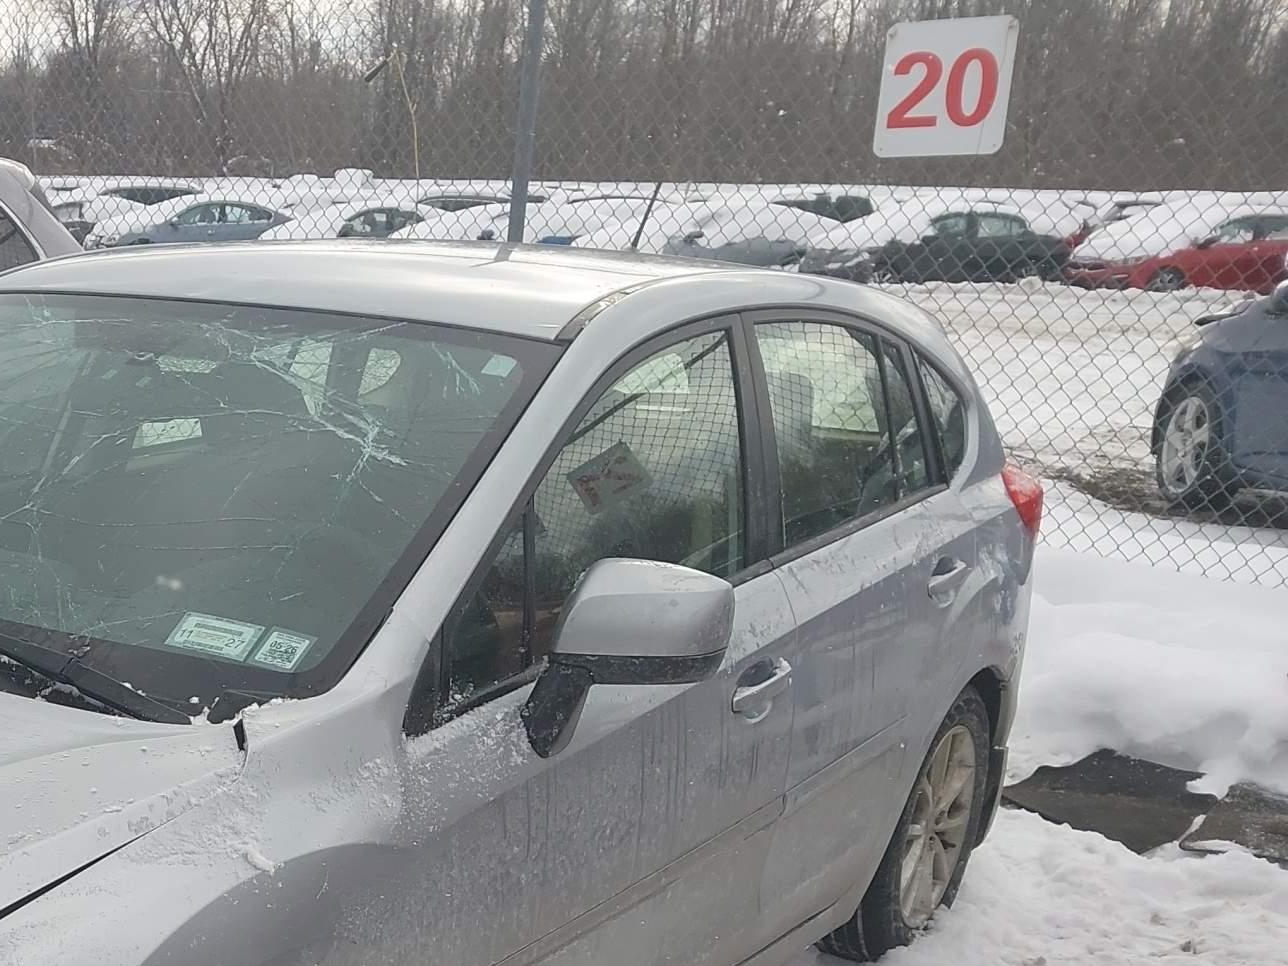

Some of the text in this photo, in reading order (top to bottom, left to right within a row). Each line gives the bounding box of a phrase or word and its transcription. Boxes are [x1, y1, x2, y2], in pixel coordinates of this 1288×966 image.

[886, 47, 999, 129] 20
[179, 628, 194, 639] 11
[224, 638, 246, 649] 27
